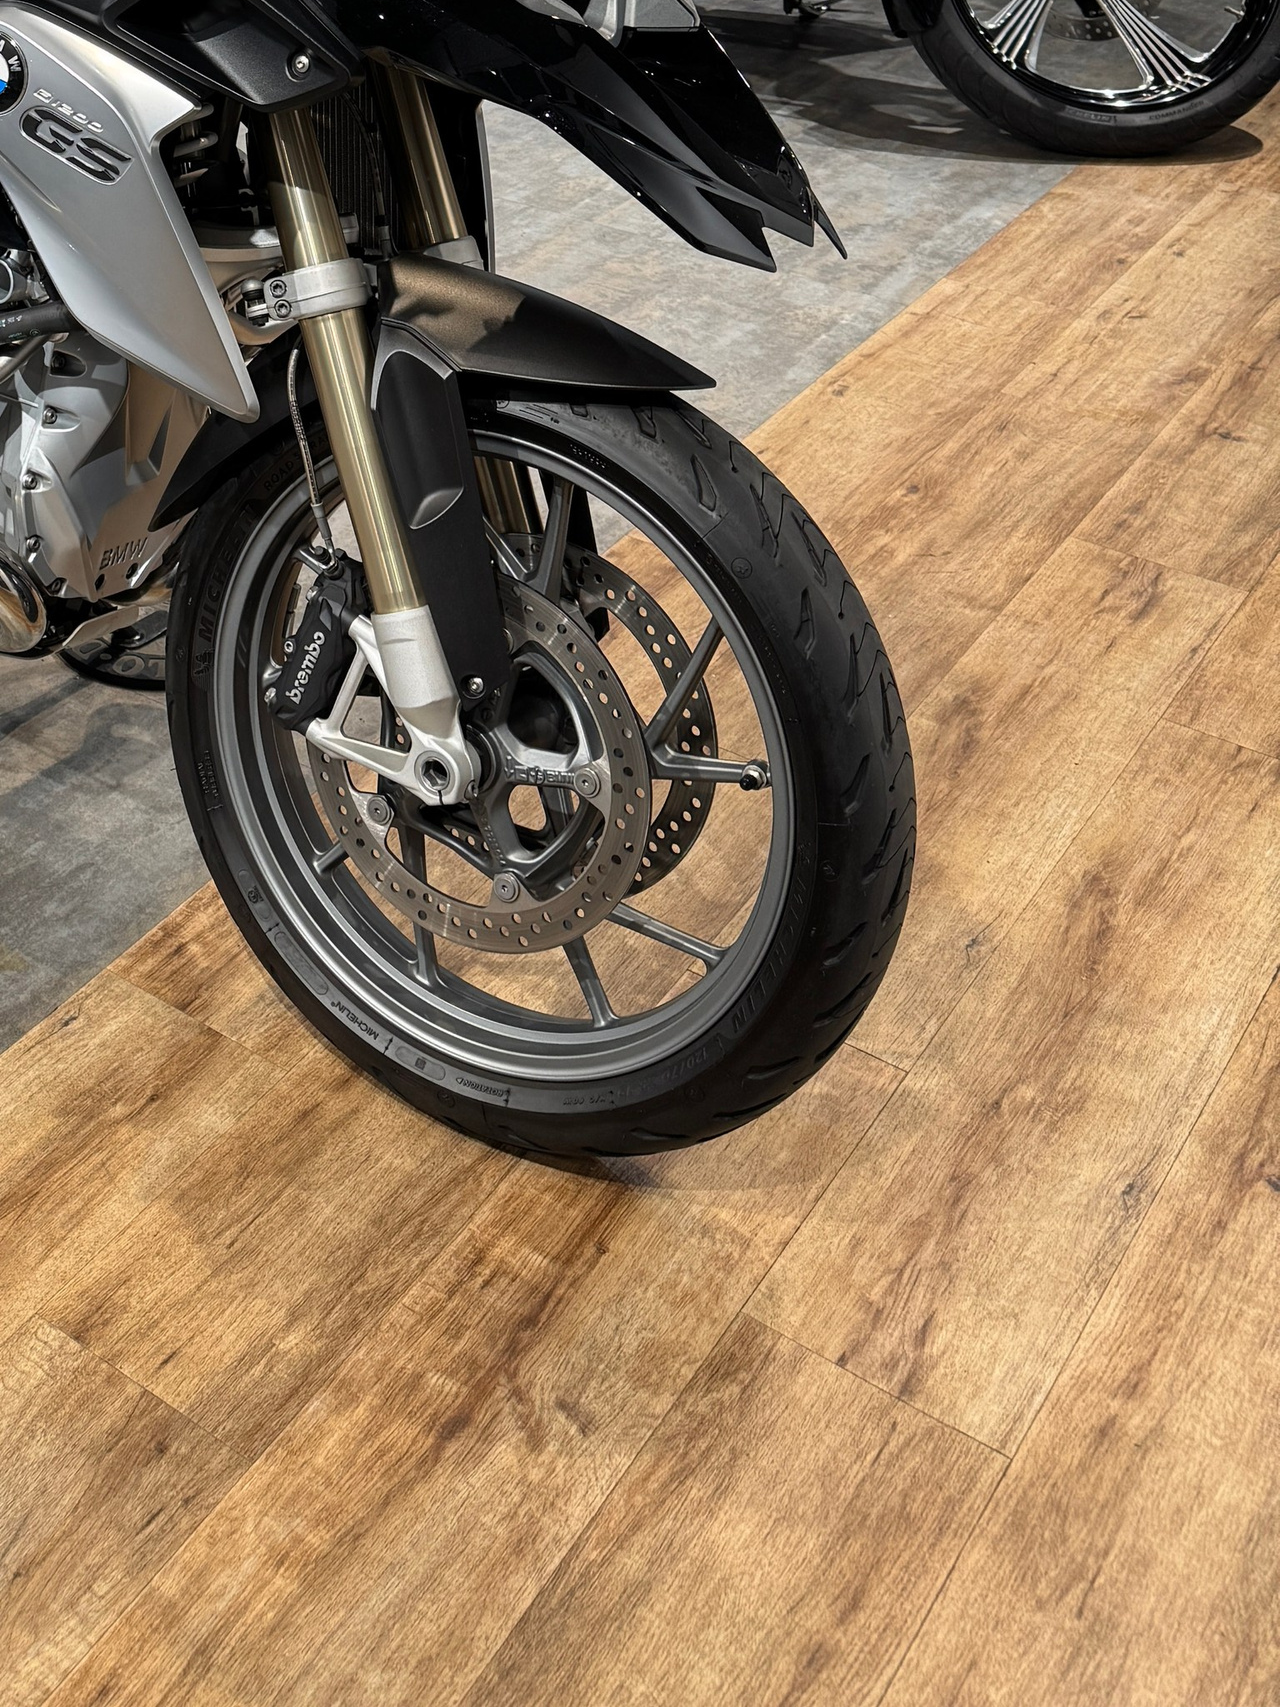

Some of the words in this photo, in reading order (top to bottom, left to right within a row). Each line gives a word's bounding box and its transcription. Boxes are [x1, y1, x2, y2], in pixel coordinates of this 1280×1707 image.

[20, 107, 133, 184] GS
[98, 537, 149, 571] BMW
[285, 630, 327, 705] brembo
